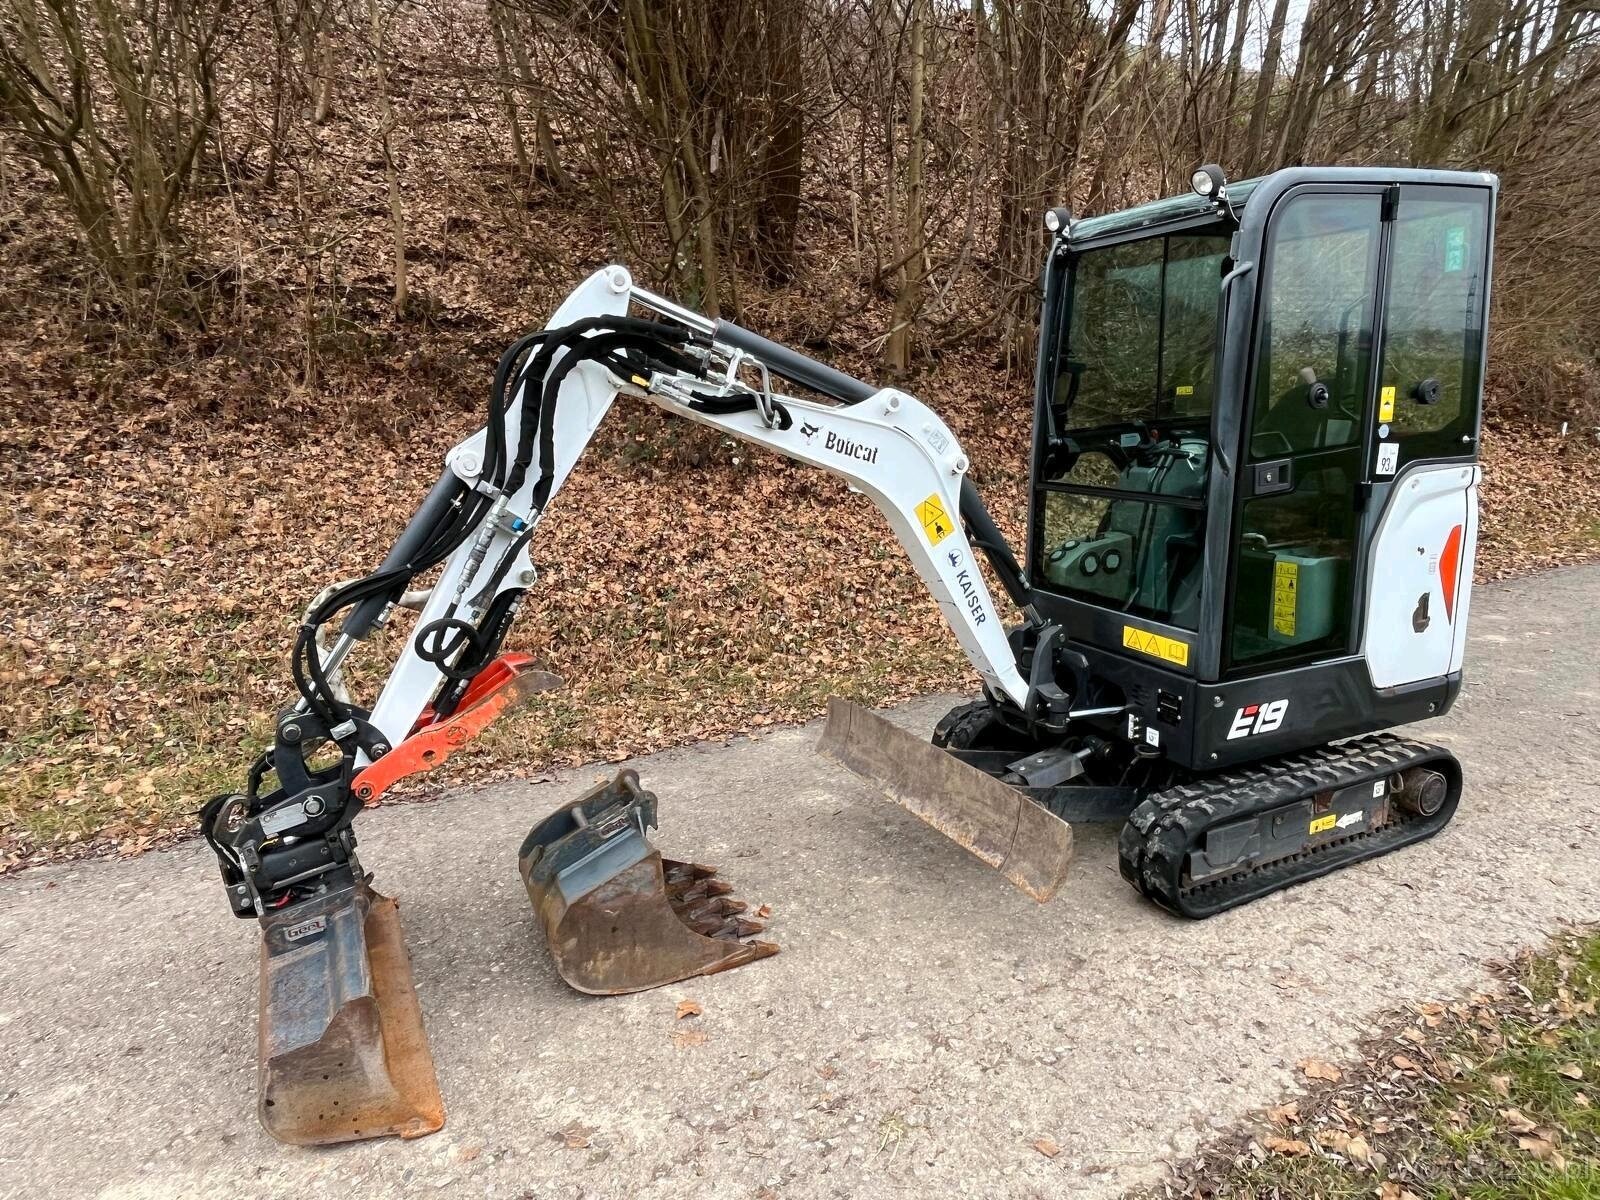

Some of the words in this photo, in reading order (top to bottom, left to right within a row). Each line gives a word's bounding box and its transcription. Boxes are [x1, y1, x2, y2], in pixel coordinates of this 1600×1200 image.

[825, 431, 878, 464] Bobcat
[956, 569, 986, 627] KAISER
[1226, 698, 1289, 740] E19
